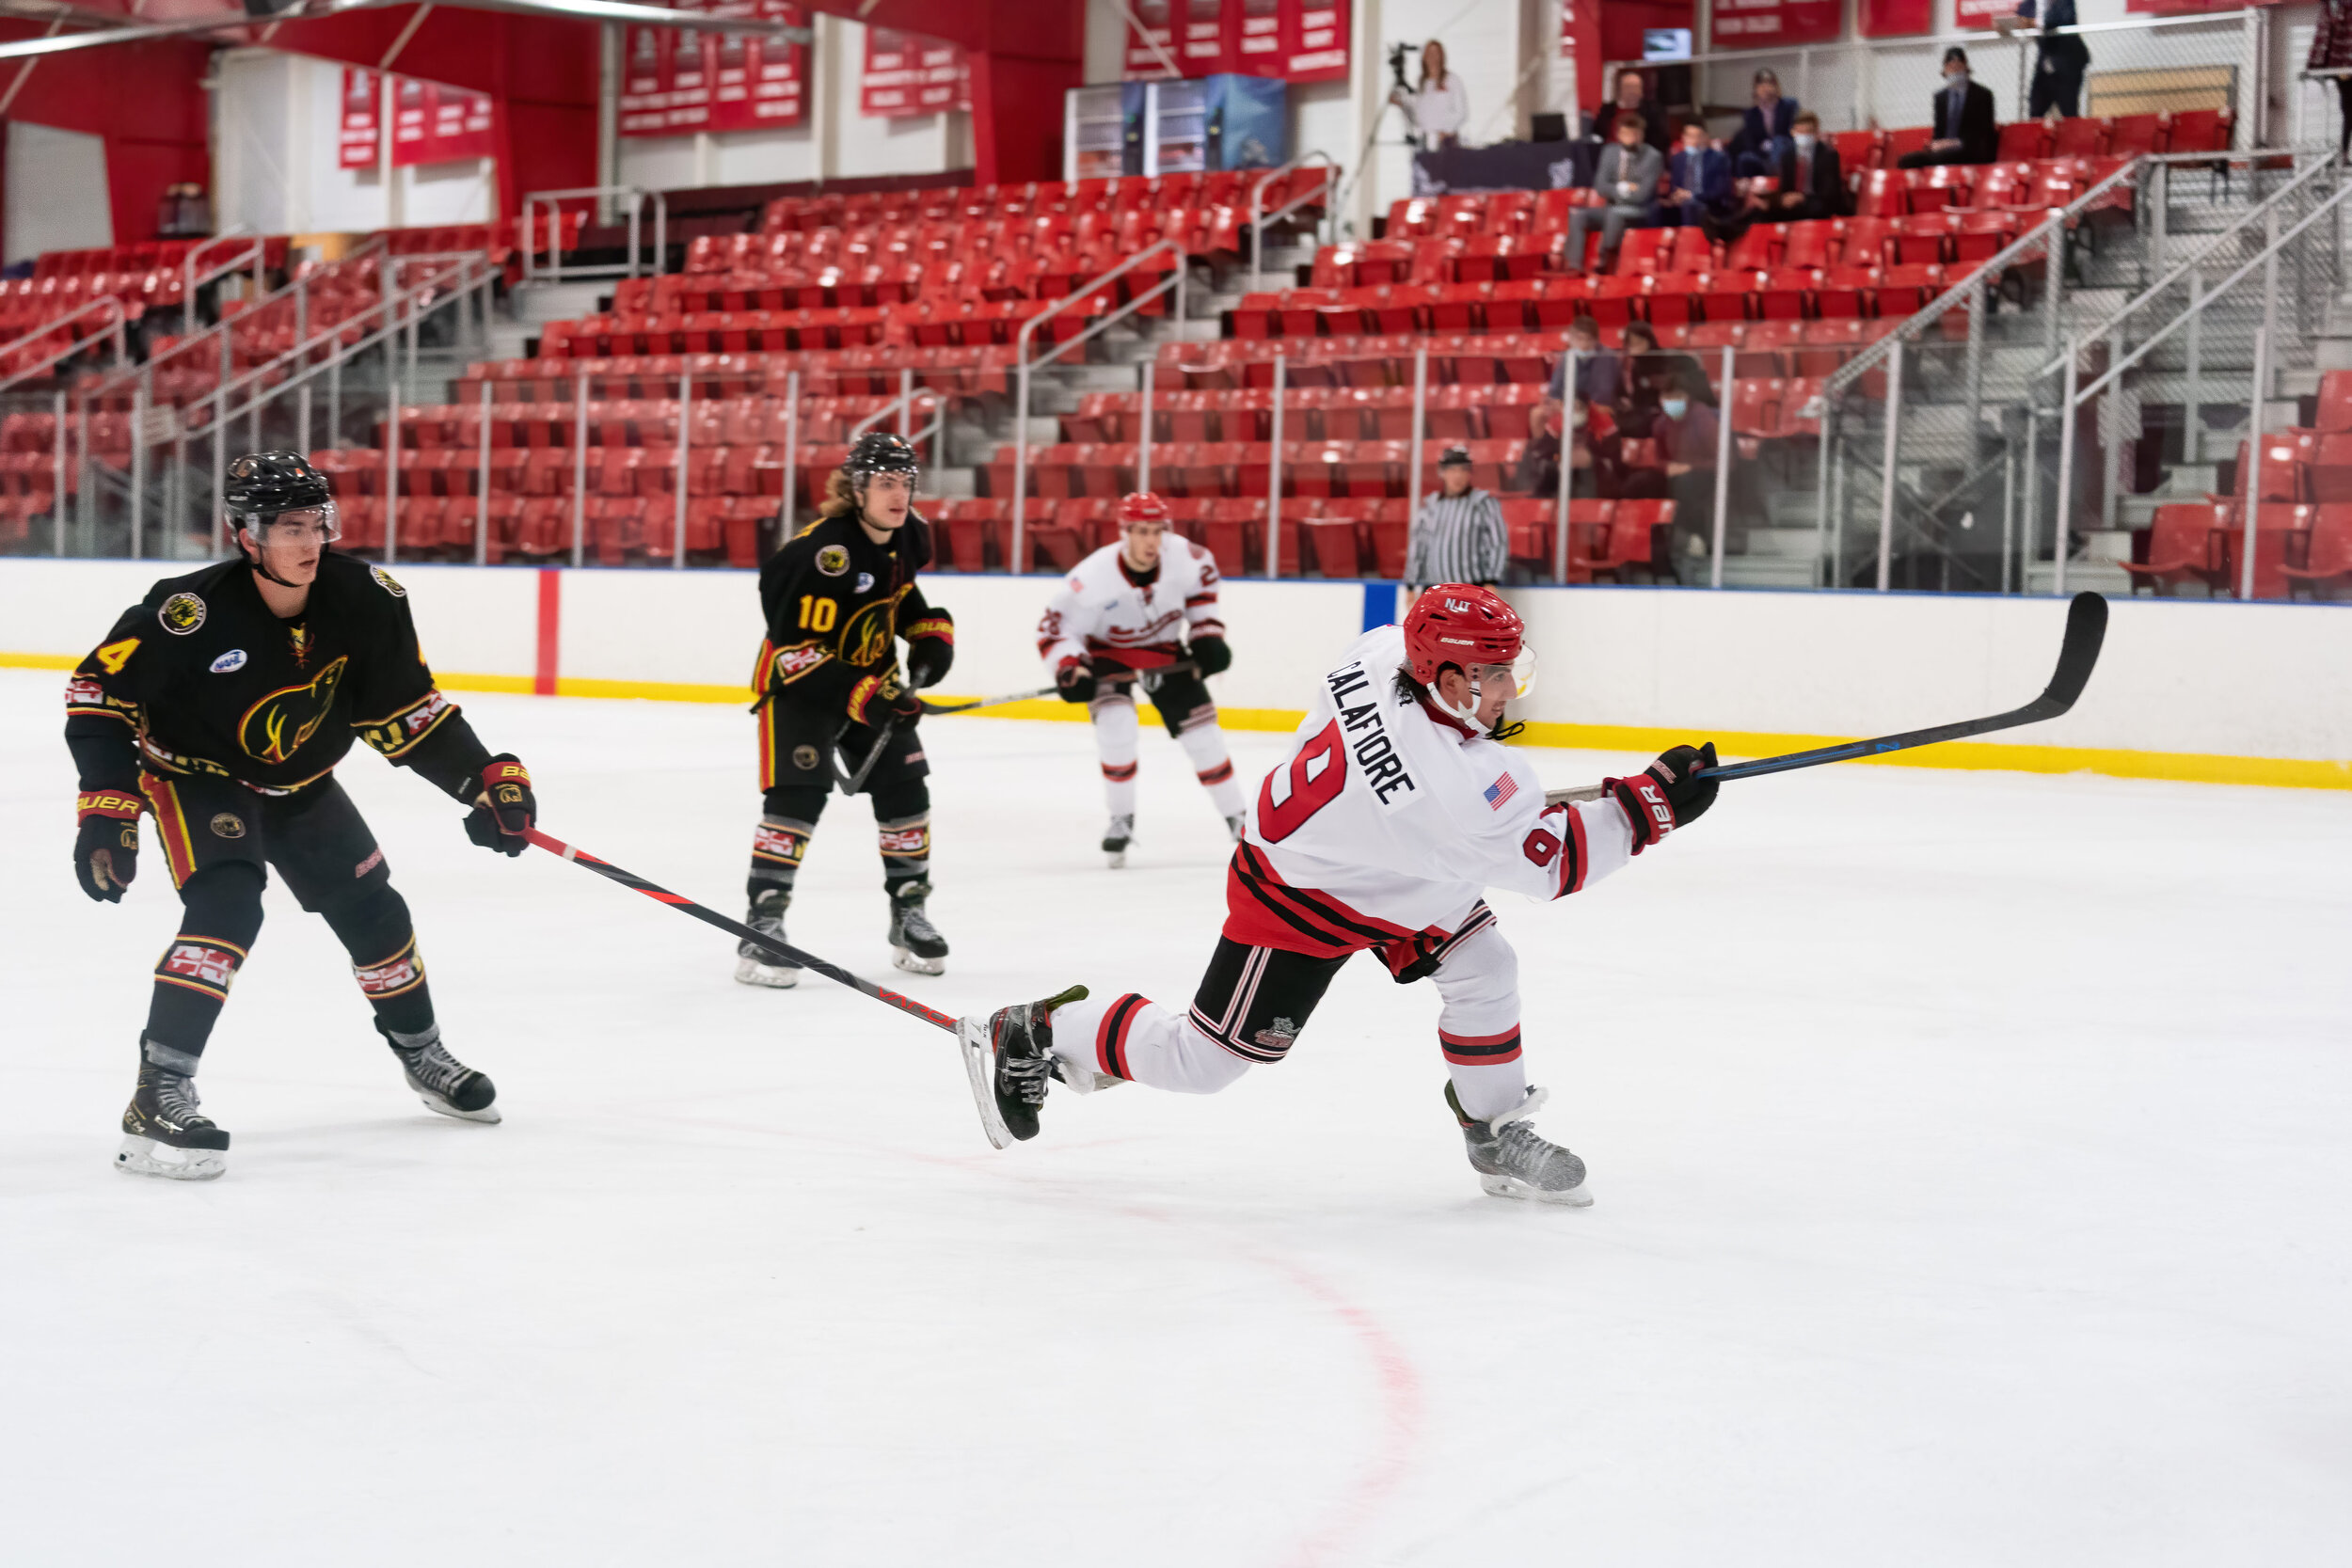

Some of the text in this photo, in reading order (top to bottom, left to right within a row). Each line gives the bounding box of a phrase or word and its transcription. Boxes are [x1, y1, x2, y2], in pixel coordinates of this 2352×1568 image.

[798, 594, 837, 632] 10
[96, 637, 141, 674] 4
[1327, 661, 1415, 805] CALAFIORE
[1258, 717, 1347, 845] 9
